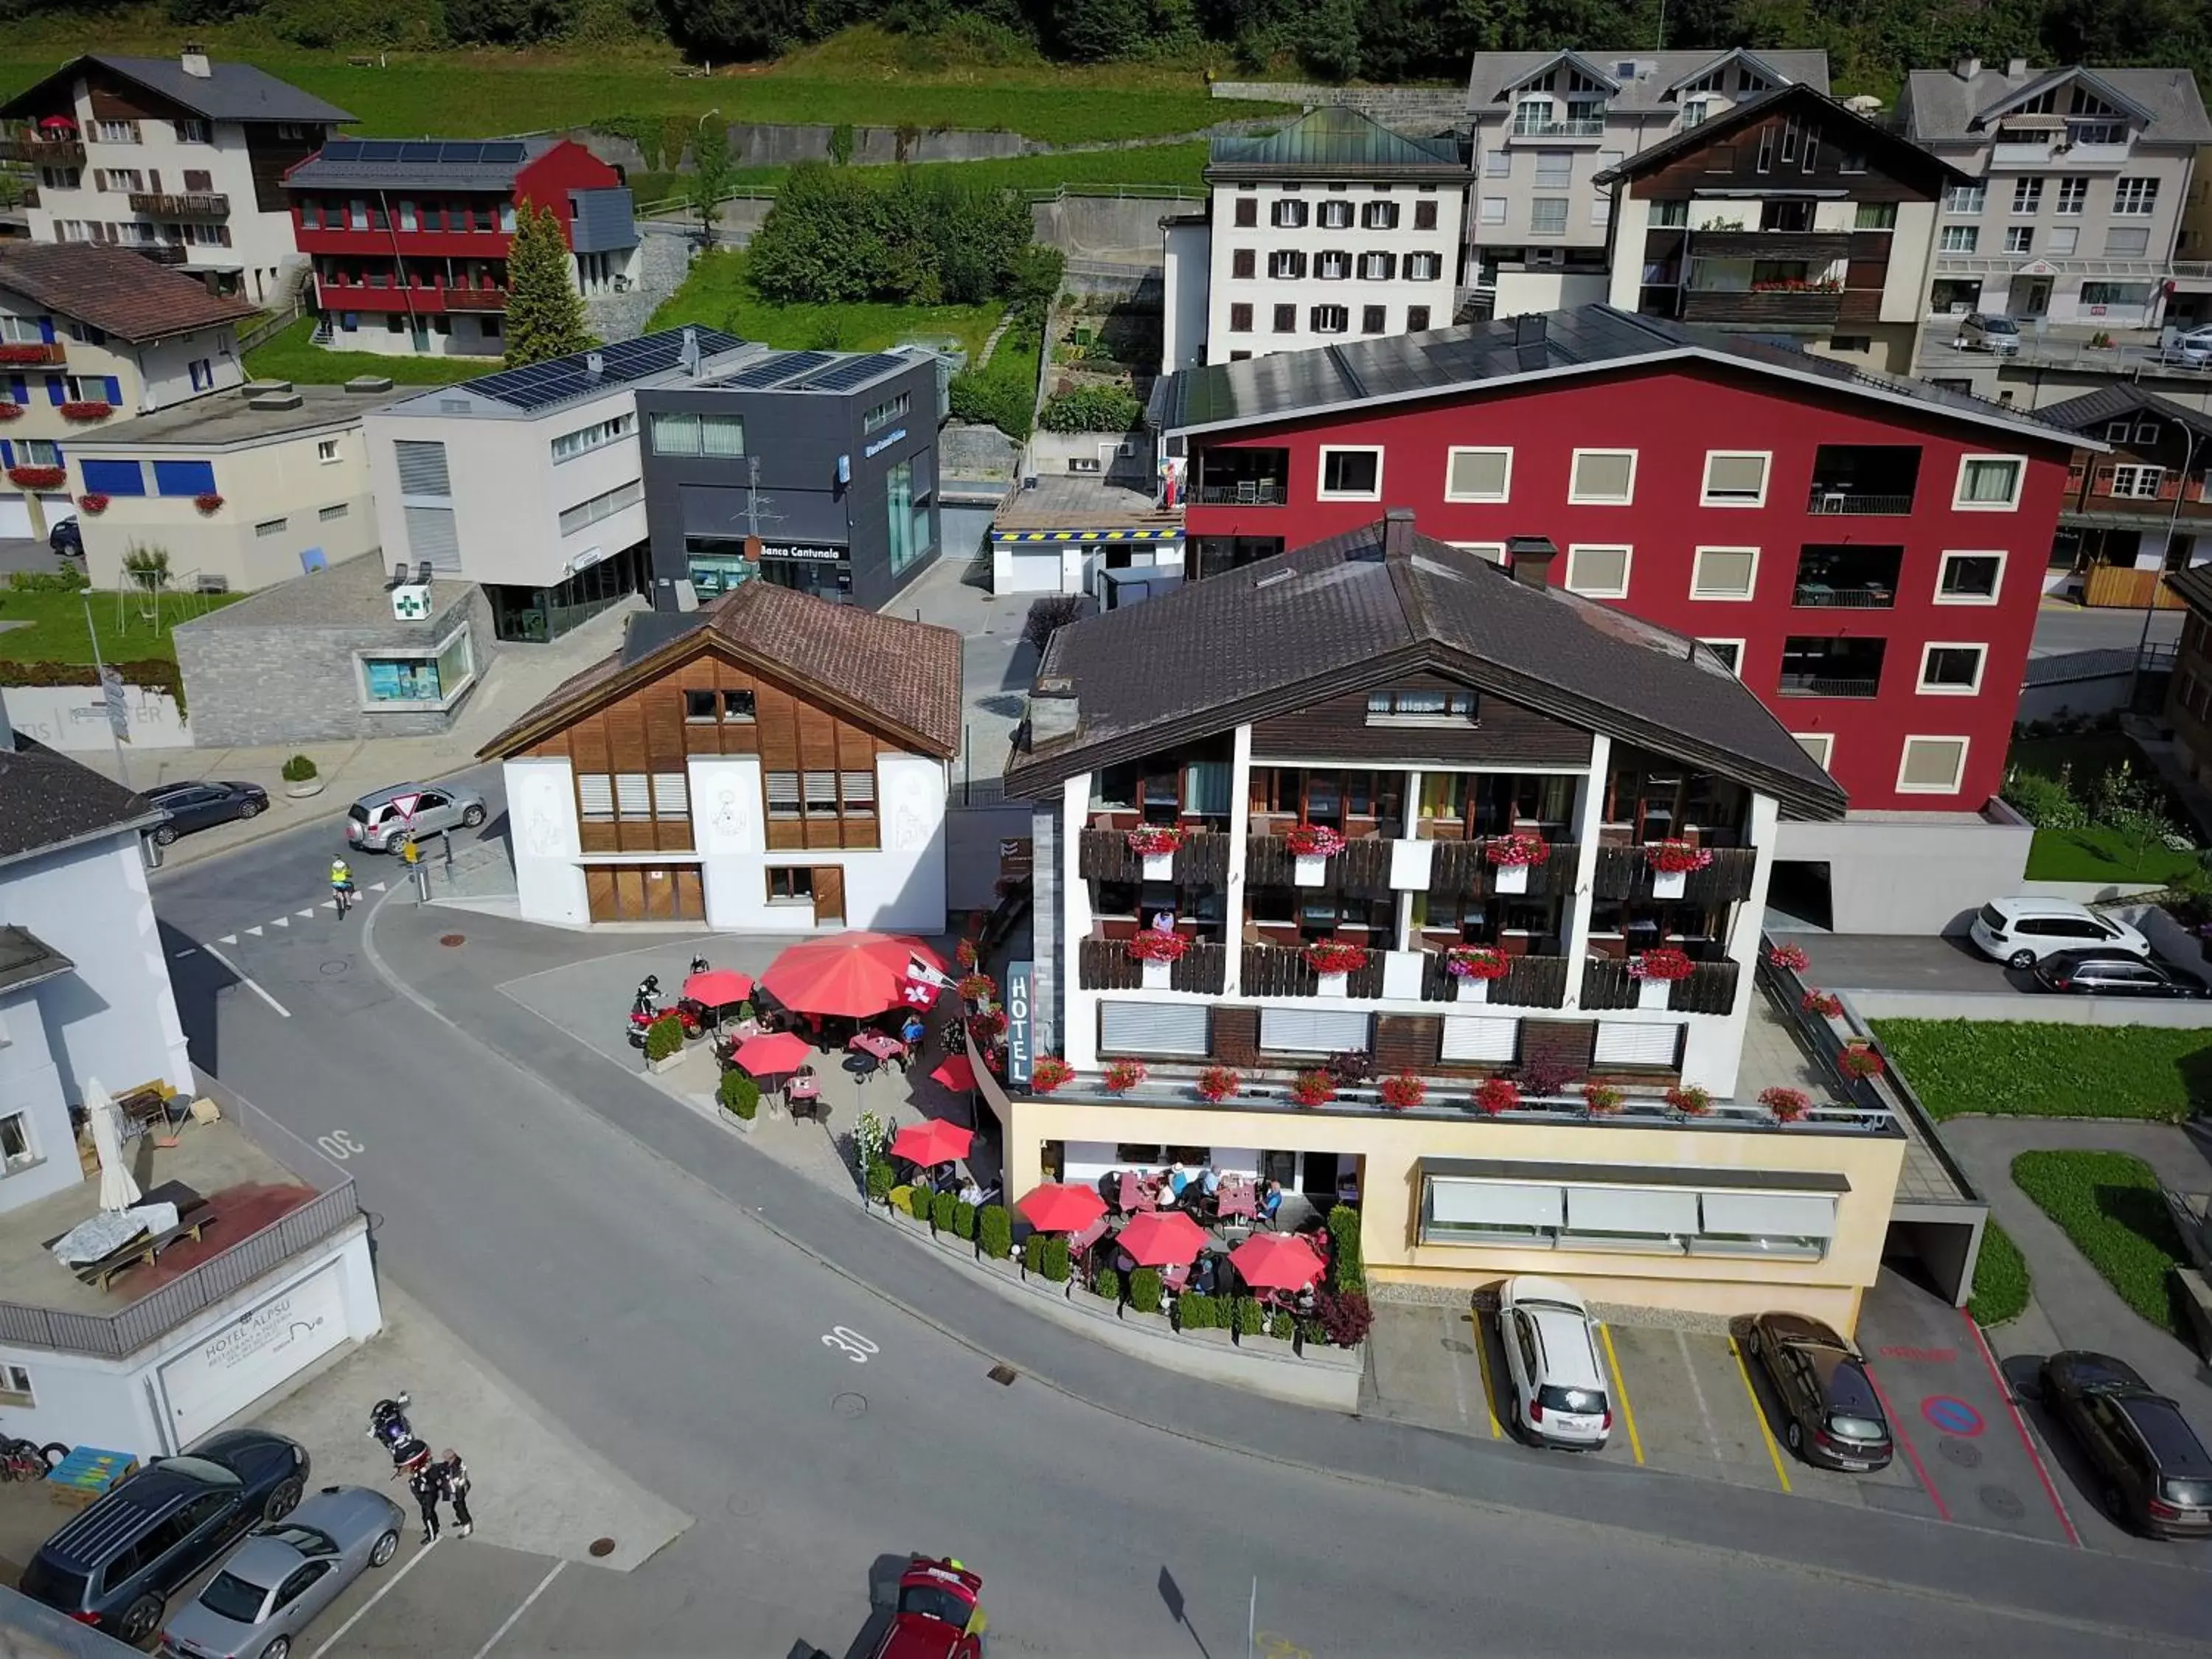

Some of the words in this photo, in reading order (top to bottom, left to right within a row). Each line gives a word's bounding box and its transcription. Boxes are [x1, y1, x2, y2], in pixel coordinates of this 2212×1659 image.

[1011, 975, 1028, 1082] HOTEL
[318, 1130, 365, 1160] 30
[206, 1328, 248, 1360] HOTEL
[821, 1326, 880, 1363] 30
